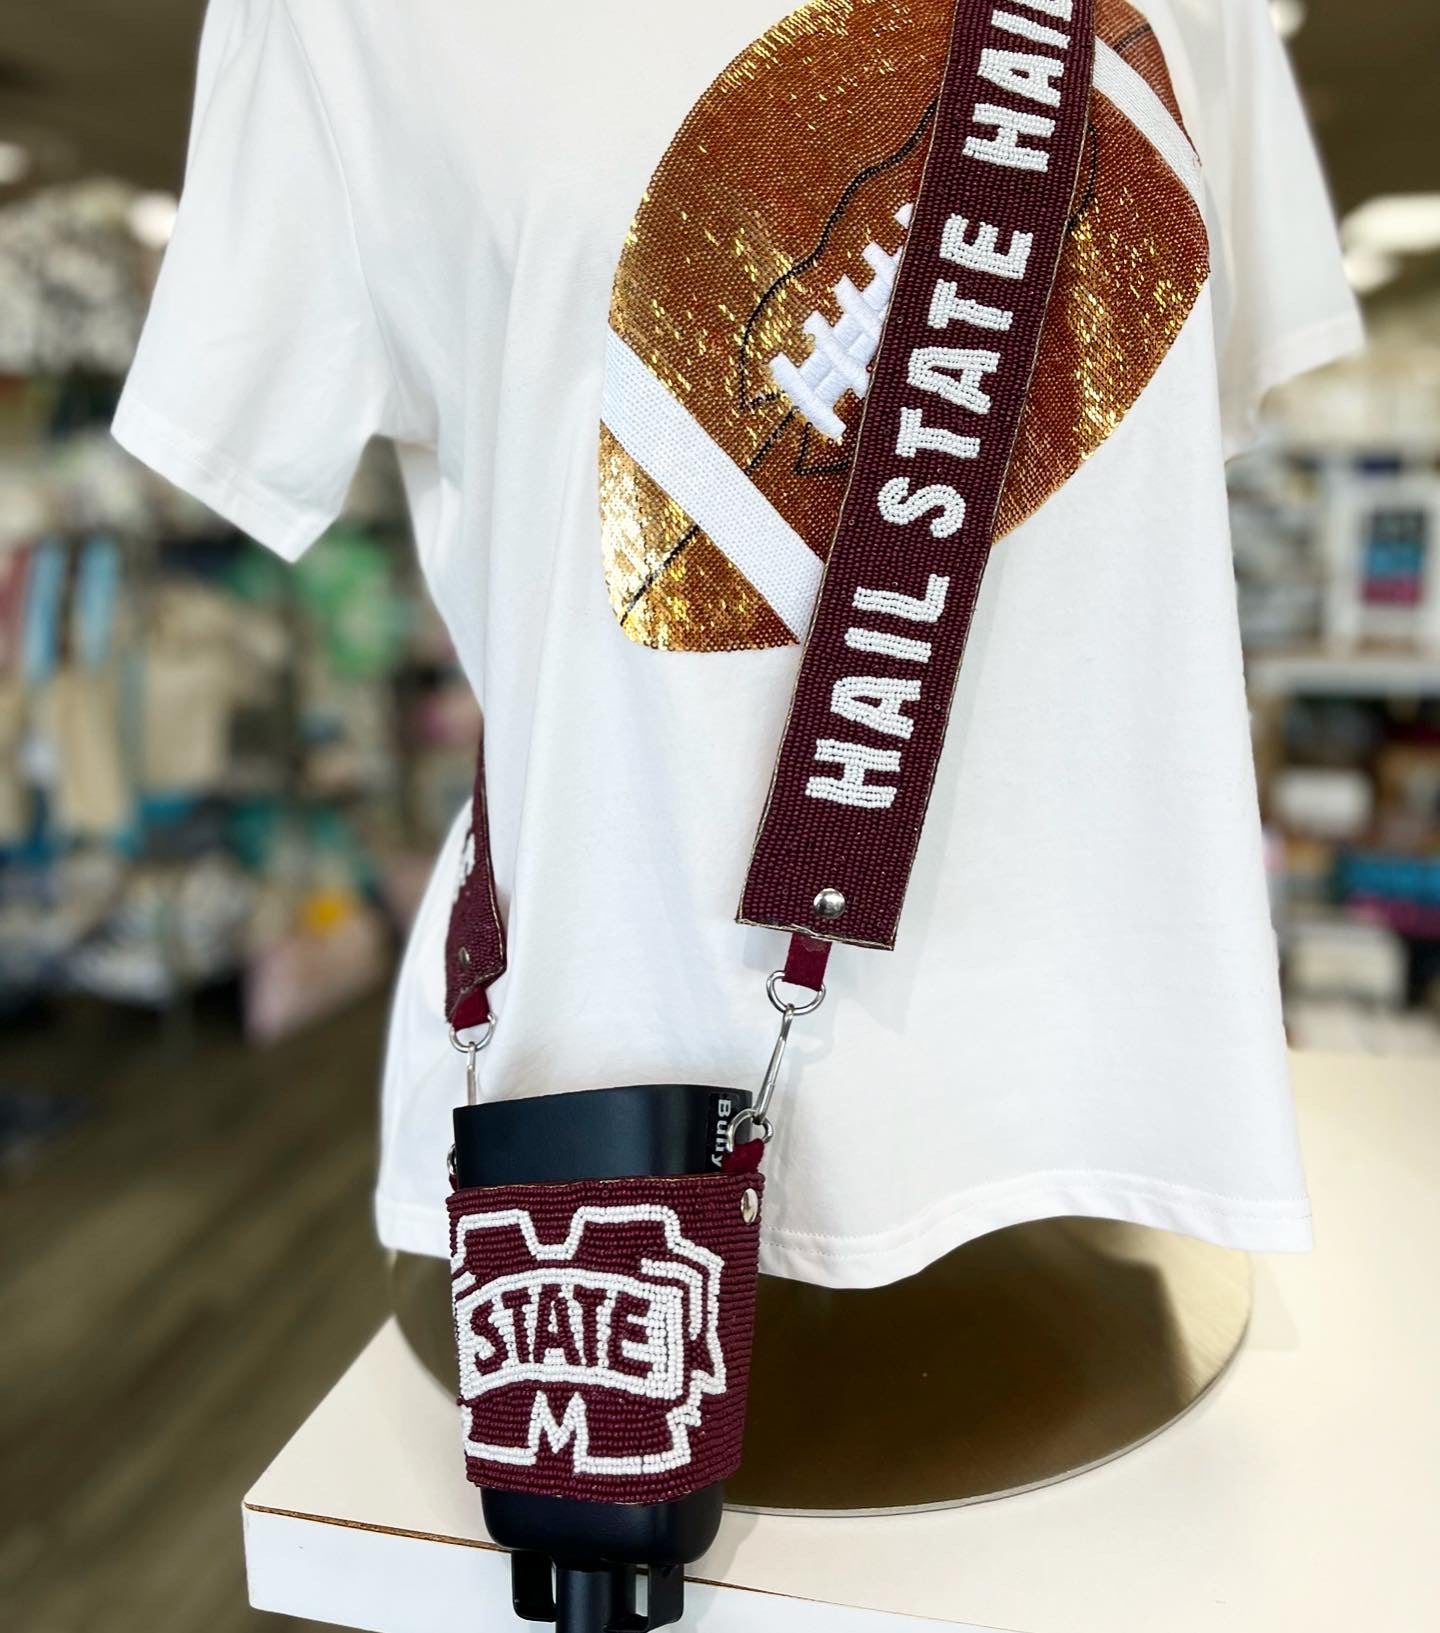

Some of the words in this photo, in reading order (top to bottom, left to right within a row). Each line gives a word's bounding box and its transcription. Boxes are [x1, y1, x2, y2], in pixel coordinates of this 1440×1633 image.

[876, 213, 1034, 539] STATE
[804, 574, 951, 810] HAIL
[470, 1284, 651, 1376] STATE
